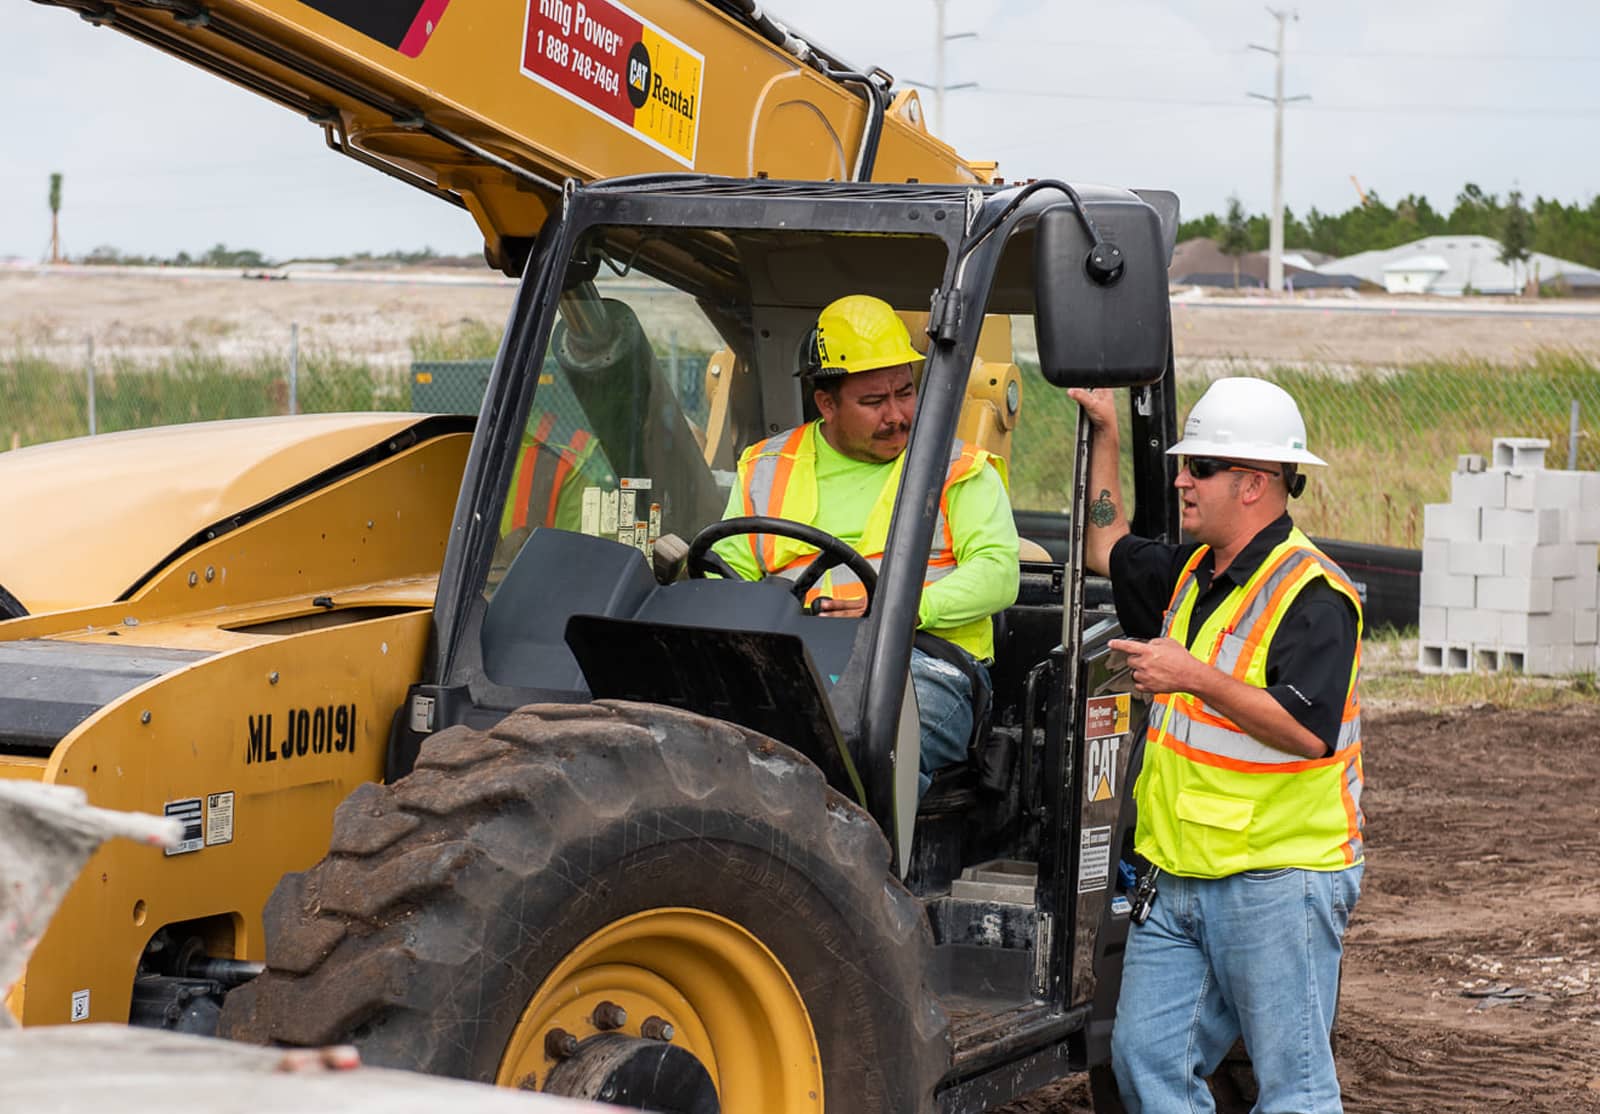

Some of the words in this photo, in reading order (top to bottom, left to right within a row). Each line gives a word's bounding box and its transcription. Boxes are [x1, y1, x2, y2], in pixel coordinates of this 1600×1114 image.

[538, 29, 544, 54] 1
[546, 34, 569, 67] 888
[571, 48, 619, 96] 748-7464
[629, 58, 648, 92] CAT
[652, 72, 695, 120] Rental
[1088, 737, 1120, 801] CAT
